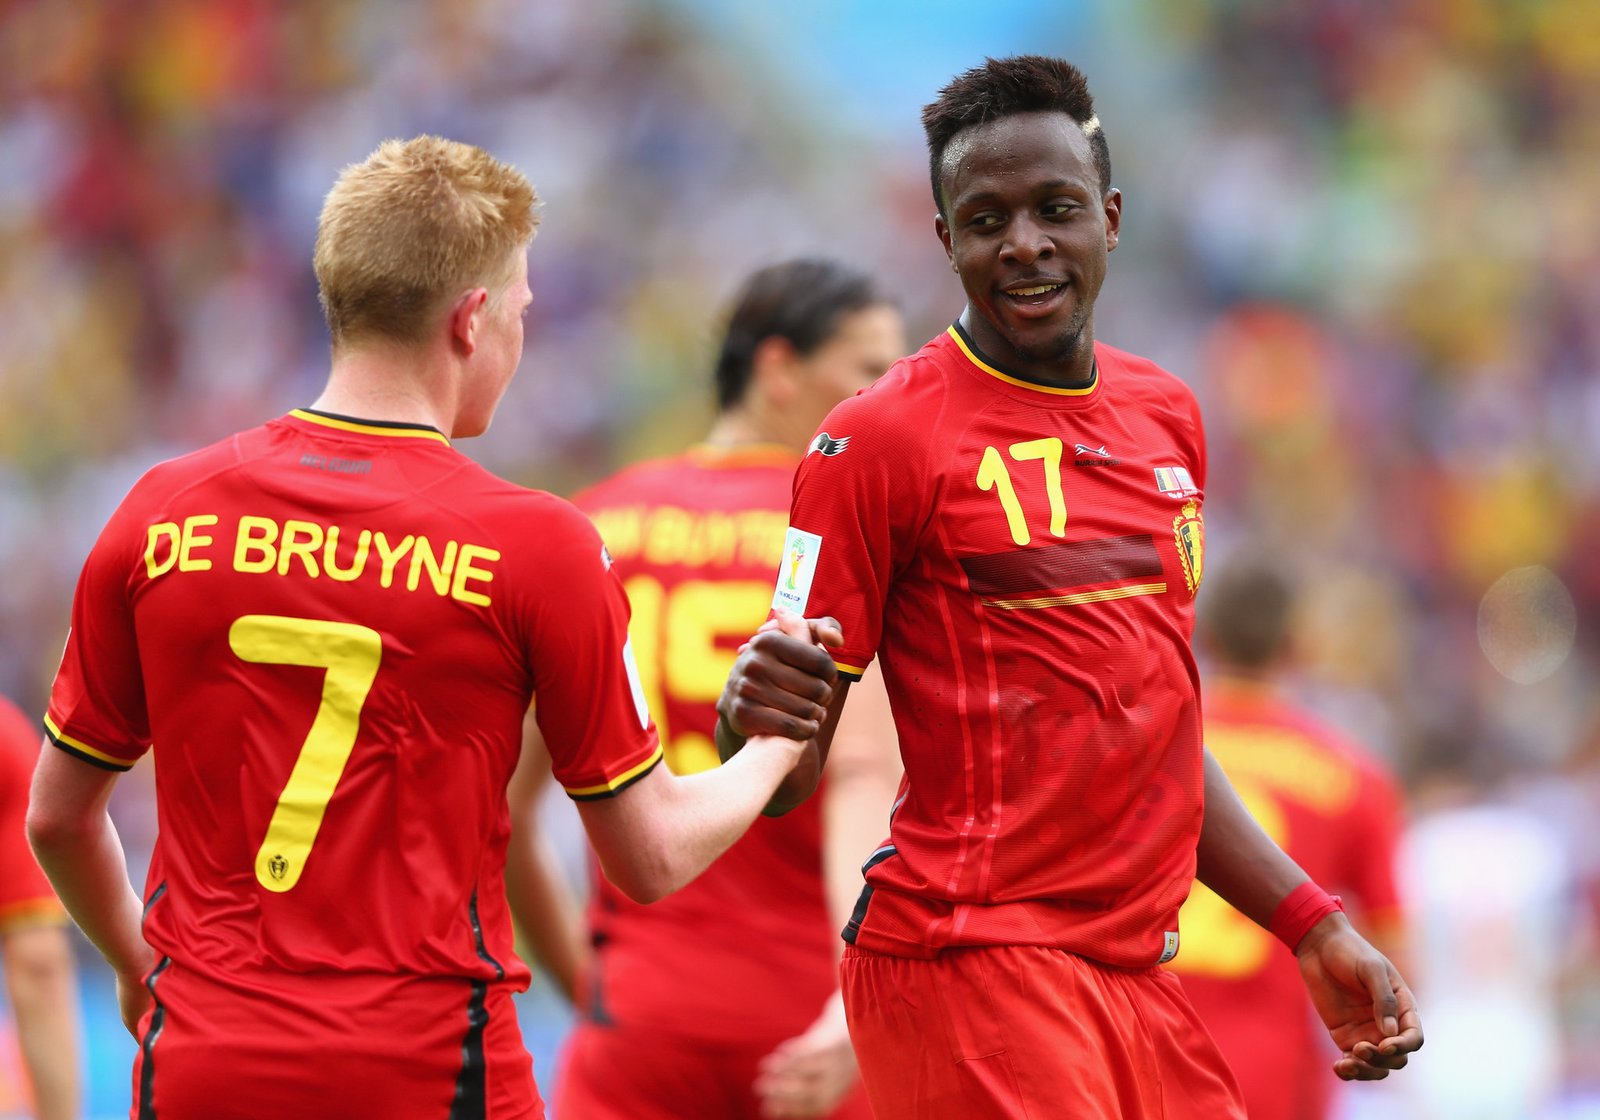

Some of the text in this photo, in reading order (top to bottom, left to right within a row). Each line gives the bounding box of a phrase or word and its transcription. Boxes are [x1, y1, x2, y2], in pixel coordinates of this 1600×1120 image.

[975, 436, 1068, 547] 17
[144, 514, 219, 579] DE
[232, 515, 501, 608] BRUYNE
[228, 614, 383, 893] 7
